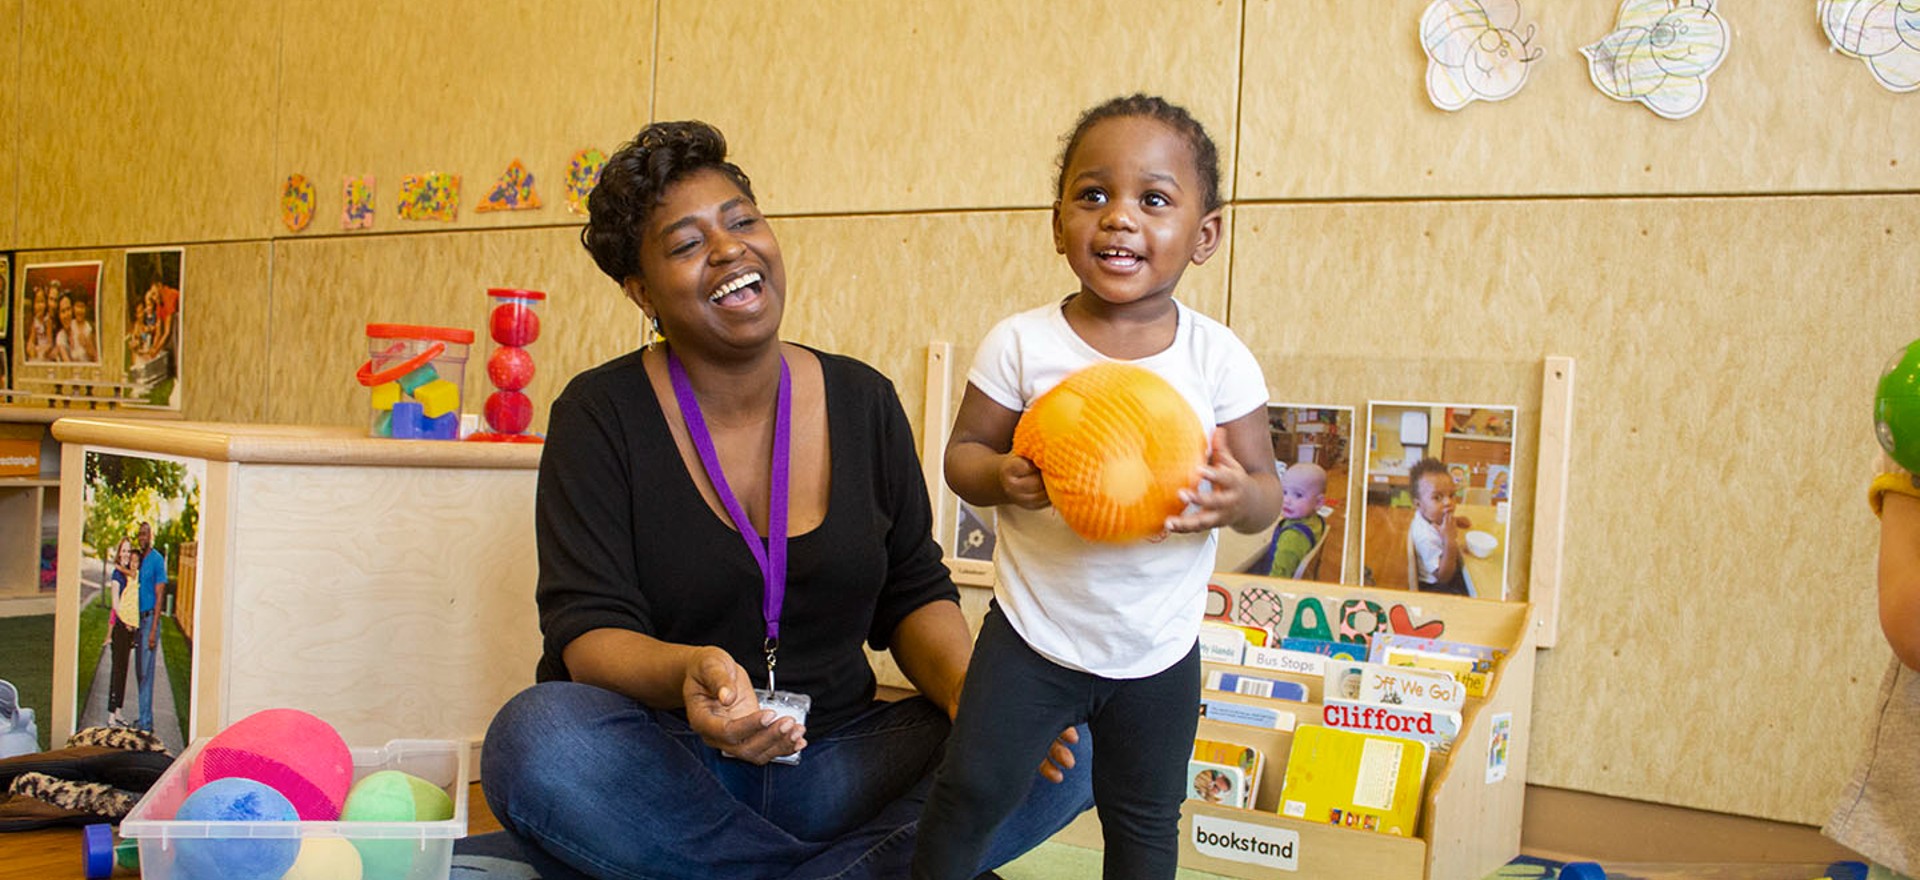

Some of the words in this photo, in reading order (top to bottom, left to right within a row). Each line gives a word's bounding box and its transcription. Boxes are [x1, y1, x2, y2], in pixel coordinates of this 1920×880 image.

[1257, 653, 1278, 667] Bus
[1280, 656, 1315, 673] Stops
[1401, 680, 1423, 697] We
[1429, 682, 1457, 702] Go!
[1323, 704, 1435, 735] Clifford
[1196, 826, 1293, 859] bookstand
